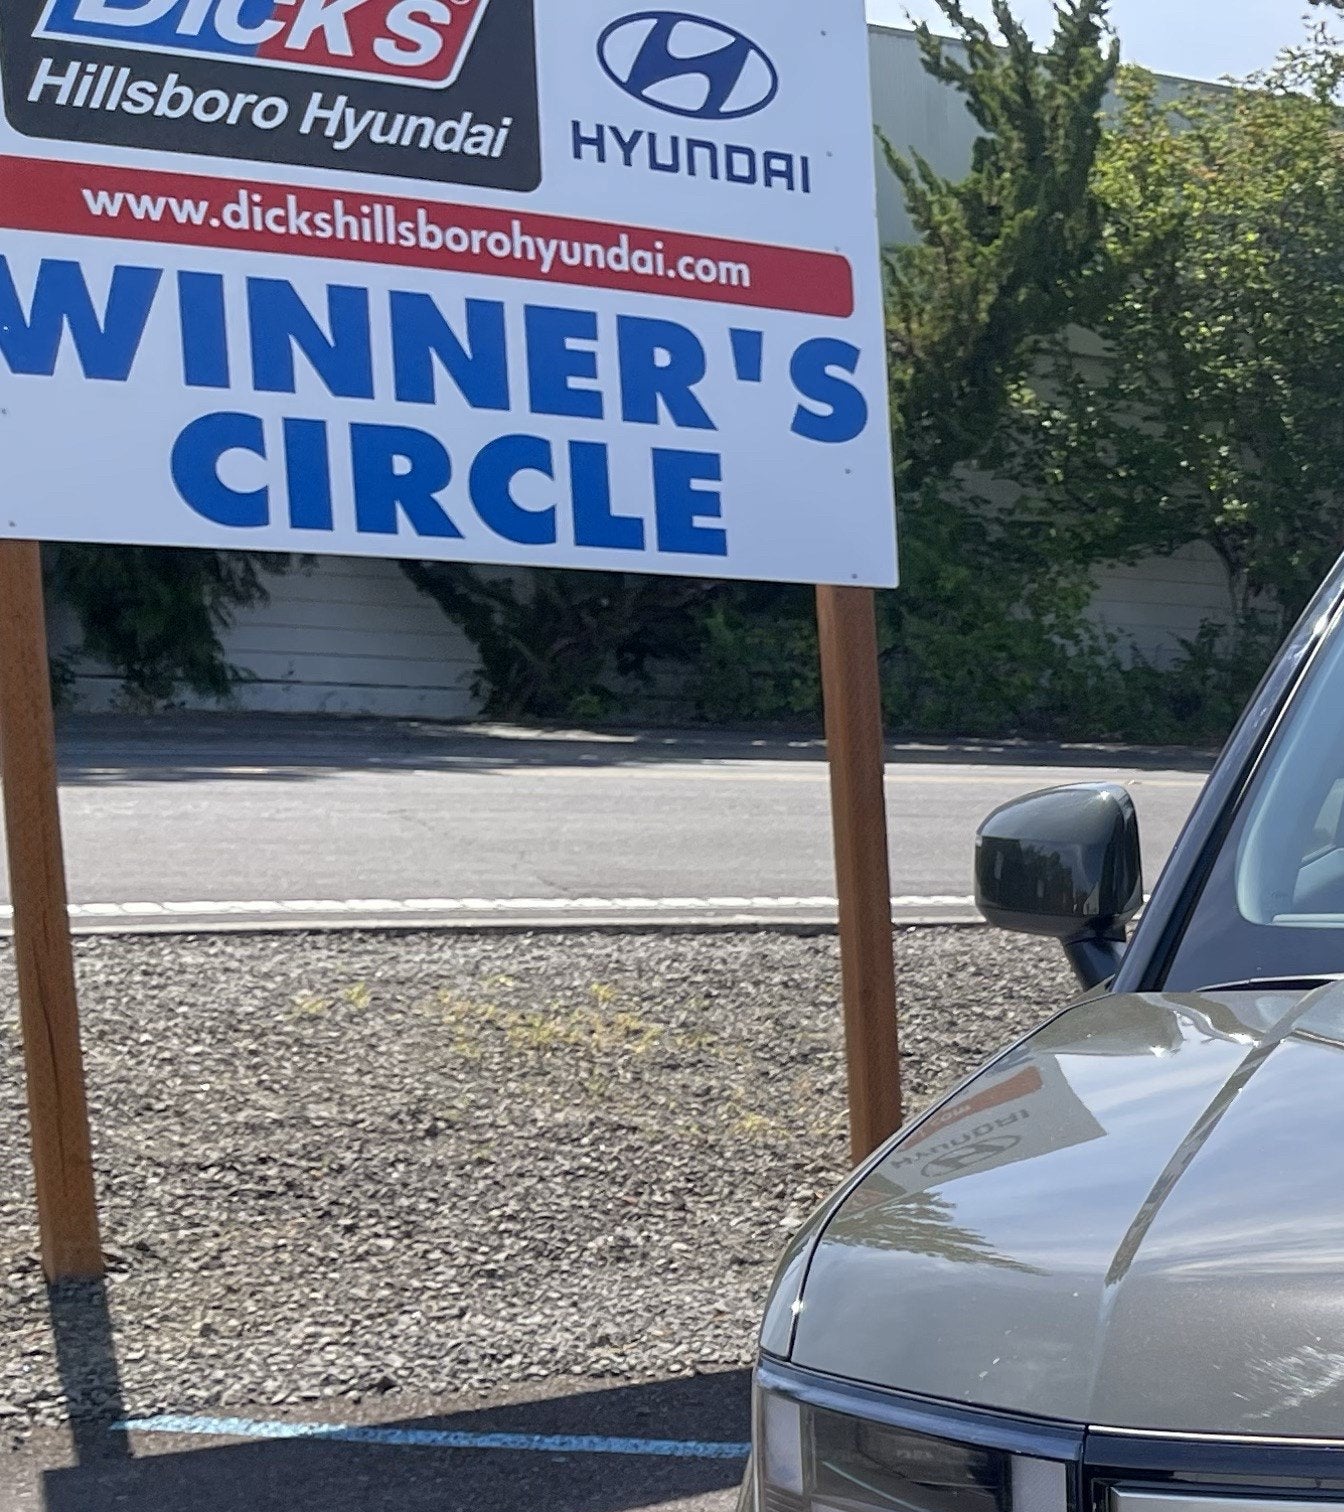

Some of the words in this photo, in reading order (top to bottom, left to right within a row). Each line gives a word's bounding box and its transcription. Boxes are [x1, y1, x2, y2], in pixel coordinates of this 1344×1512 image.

[27, 58, 289, 130] Hillsboro
[299, 91, 512, 158] Hyundai
[571, 121, 811, 194] HYUNDAI
[82, 187, 751, 289] www.dickshillsborohyundai.com
[0, 254, 870, 445] WINNER'S
[171, 411, 730, 558] CIRCLE
